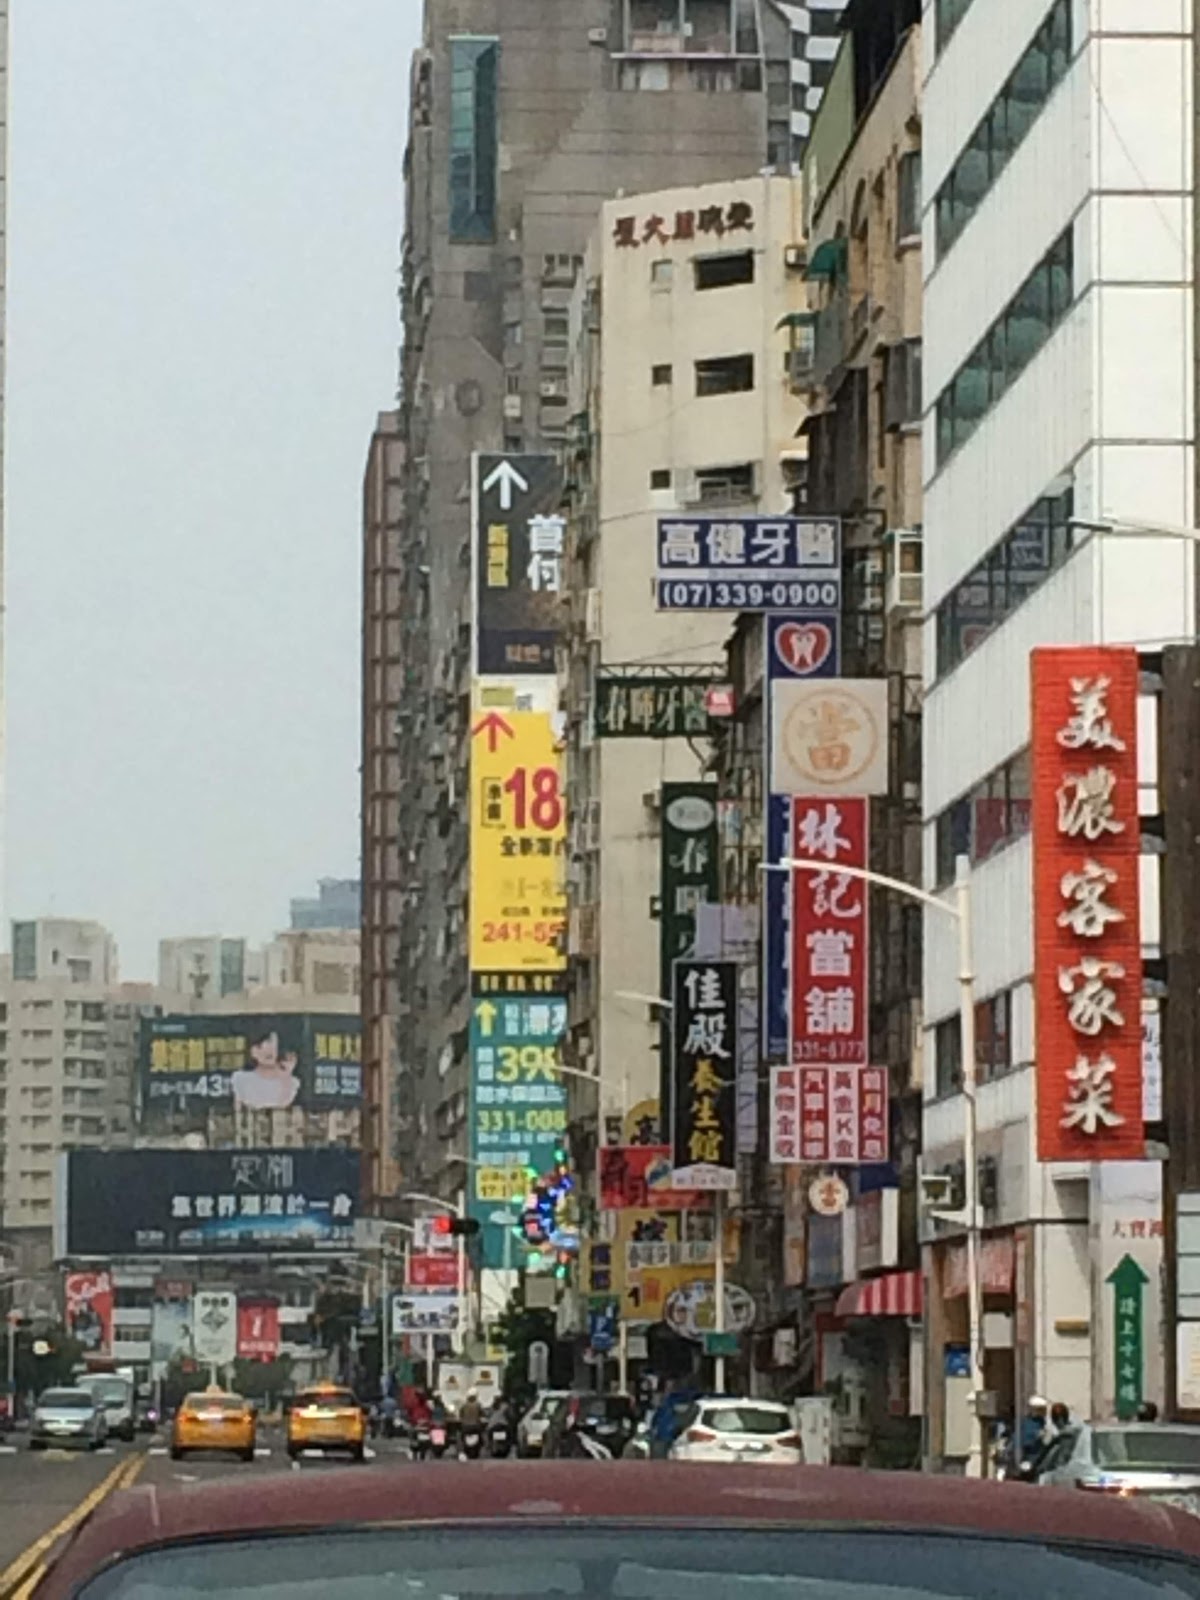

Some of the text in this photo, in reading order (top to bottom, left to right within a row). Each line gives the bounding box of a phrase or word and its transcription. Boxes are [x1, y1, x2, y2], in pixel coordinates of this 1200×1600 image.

[661, 523, 834, 565] 高健牙醫
[664, 583, 837, 606] (07)339-0900
[504, 767, 561, 831] 18
[799, 803, 862, 1035] 林記當舖
[1056, 676, 1126, 1134] 美濃客家菜
